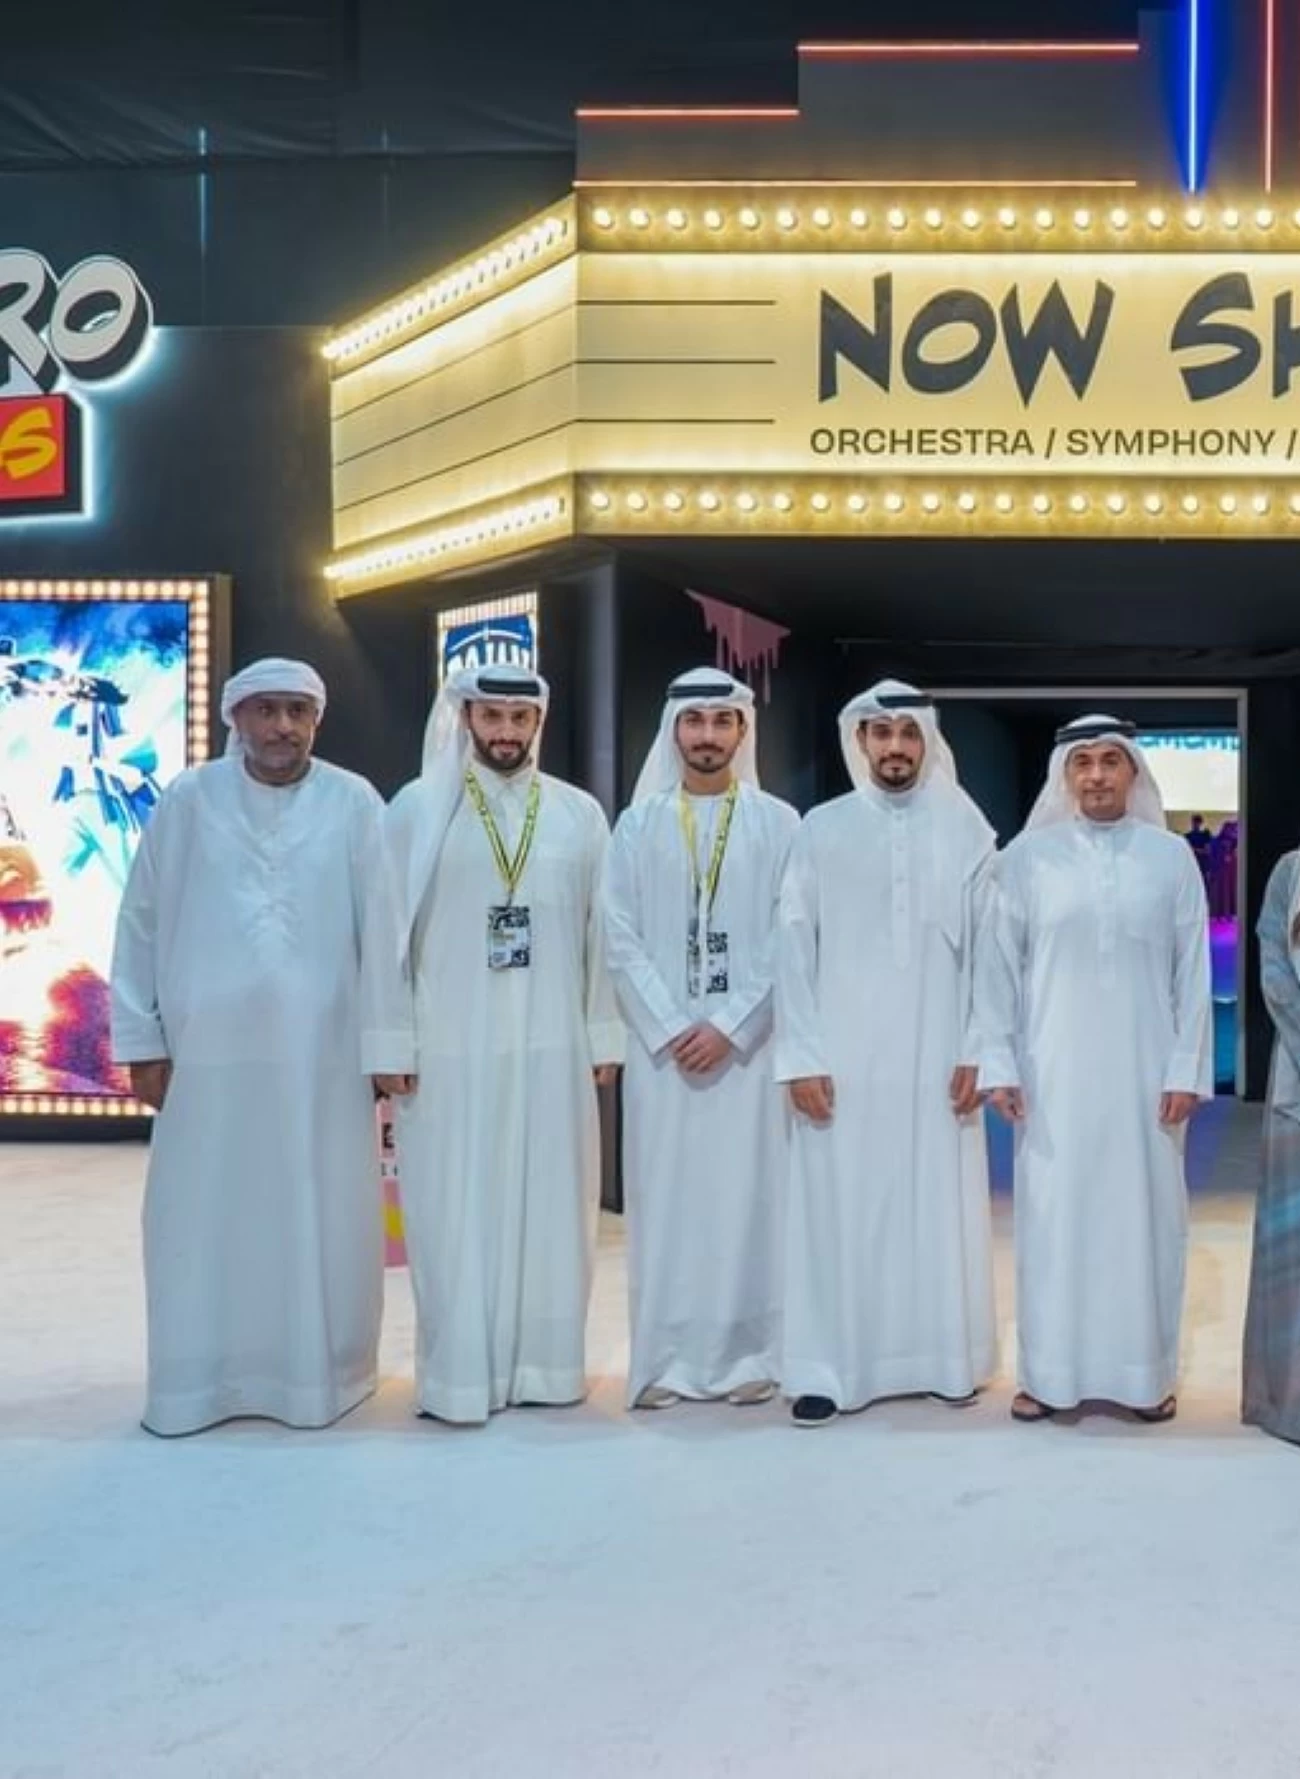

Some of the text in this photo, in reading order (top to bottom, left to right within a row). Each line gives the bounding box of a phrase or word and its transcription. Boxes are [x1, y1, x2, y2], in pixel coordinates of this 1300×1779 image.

[818, 272, 1116, 410] NOW
[0, 405, 58, 480] S
[810, 428, 1035, 456] ORCHESTRA
[1066, 428, 1275, 456] SYMPHONY
